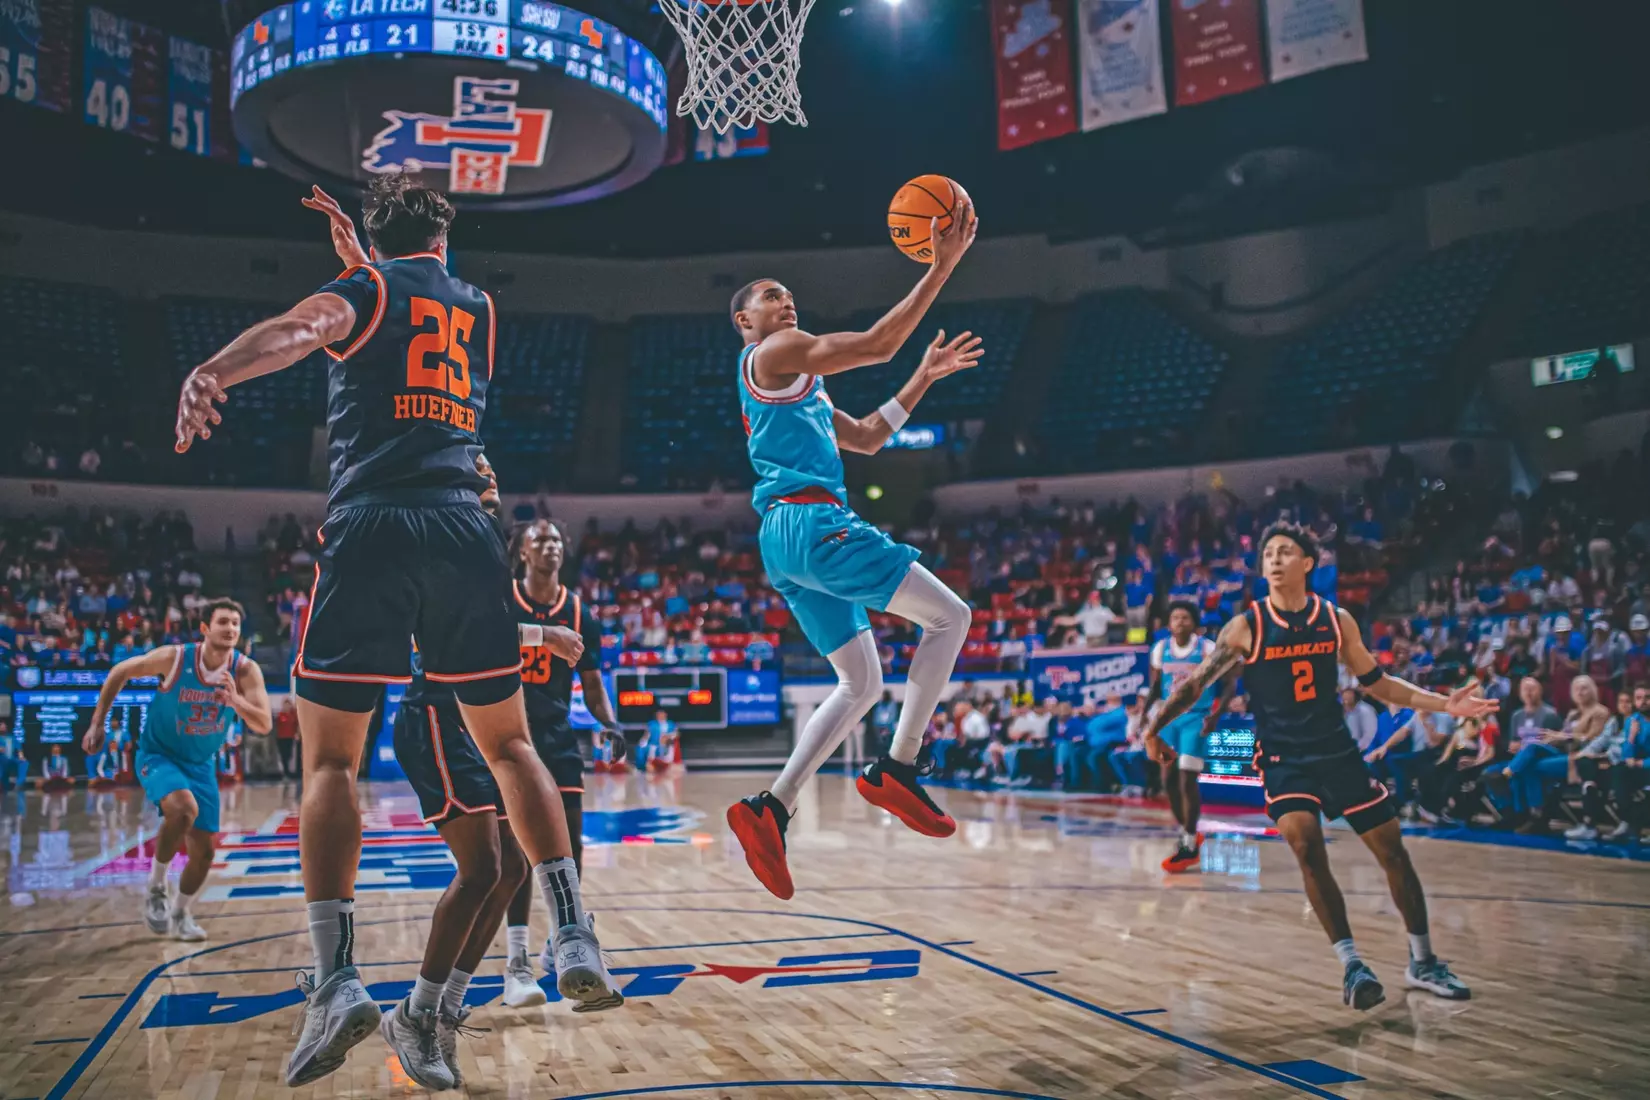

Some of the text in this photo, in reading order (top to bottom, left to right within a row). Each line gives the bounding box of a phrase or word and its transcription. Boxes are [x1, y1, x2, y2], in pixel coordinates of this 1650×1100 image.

[350, 0, 427, 15] LA TECH
[386, 23, 418, 46] 21
[453, 22, 488, 37] 1ST
[522, 35, 555, 62] 24
[87, 80, 129, 131] 40
[171, 102, 205, 155] 51
[407, 296, 476, 400] 25
[393, 394, 476, 433] HUEFNER
[520, 645, 552, 685] 23
[1264, 641, 1335, 661] BEARKATS
[1292, 660, 1317, 702] 2
[188, 704, 218, 723] 33
